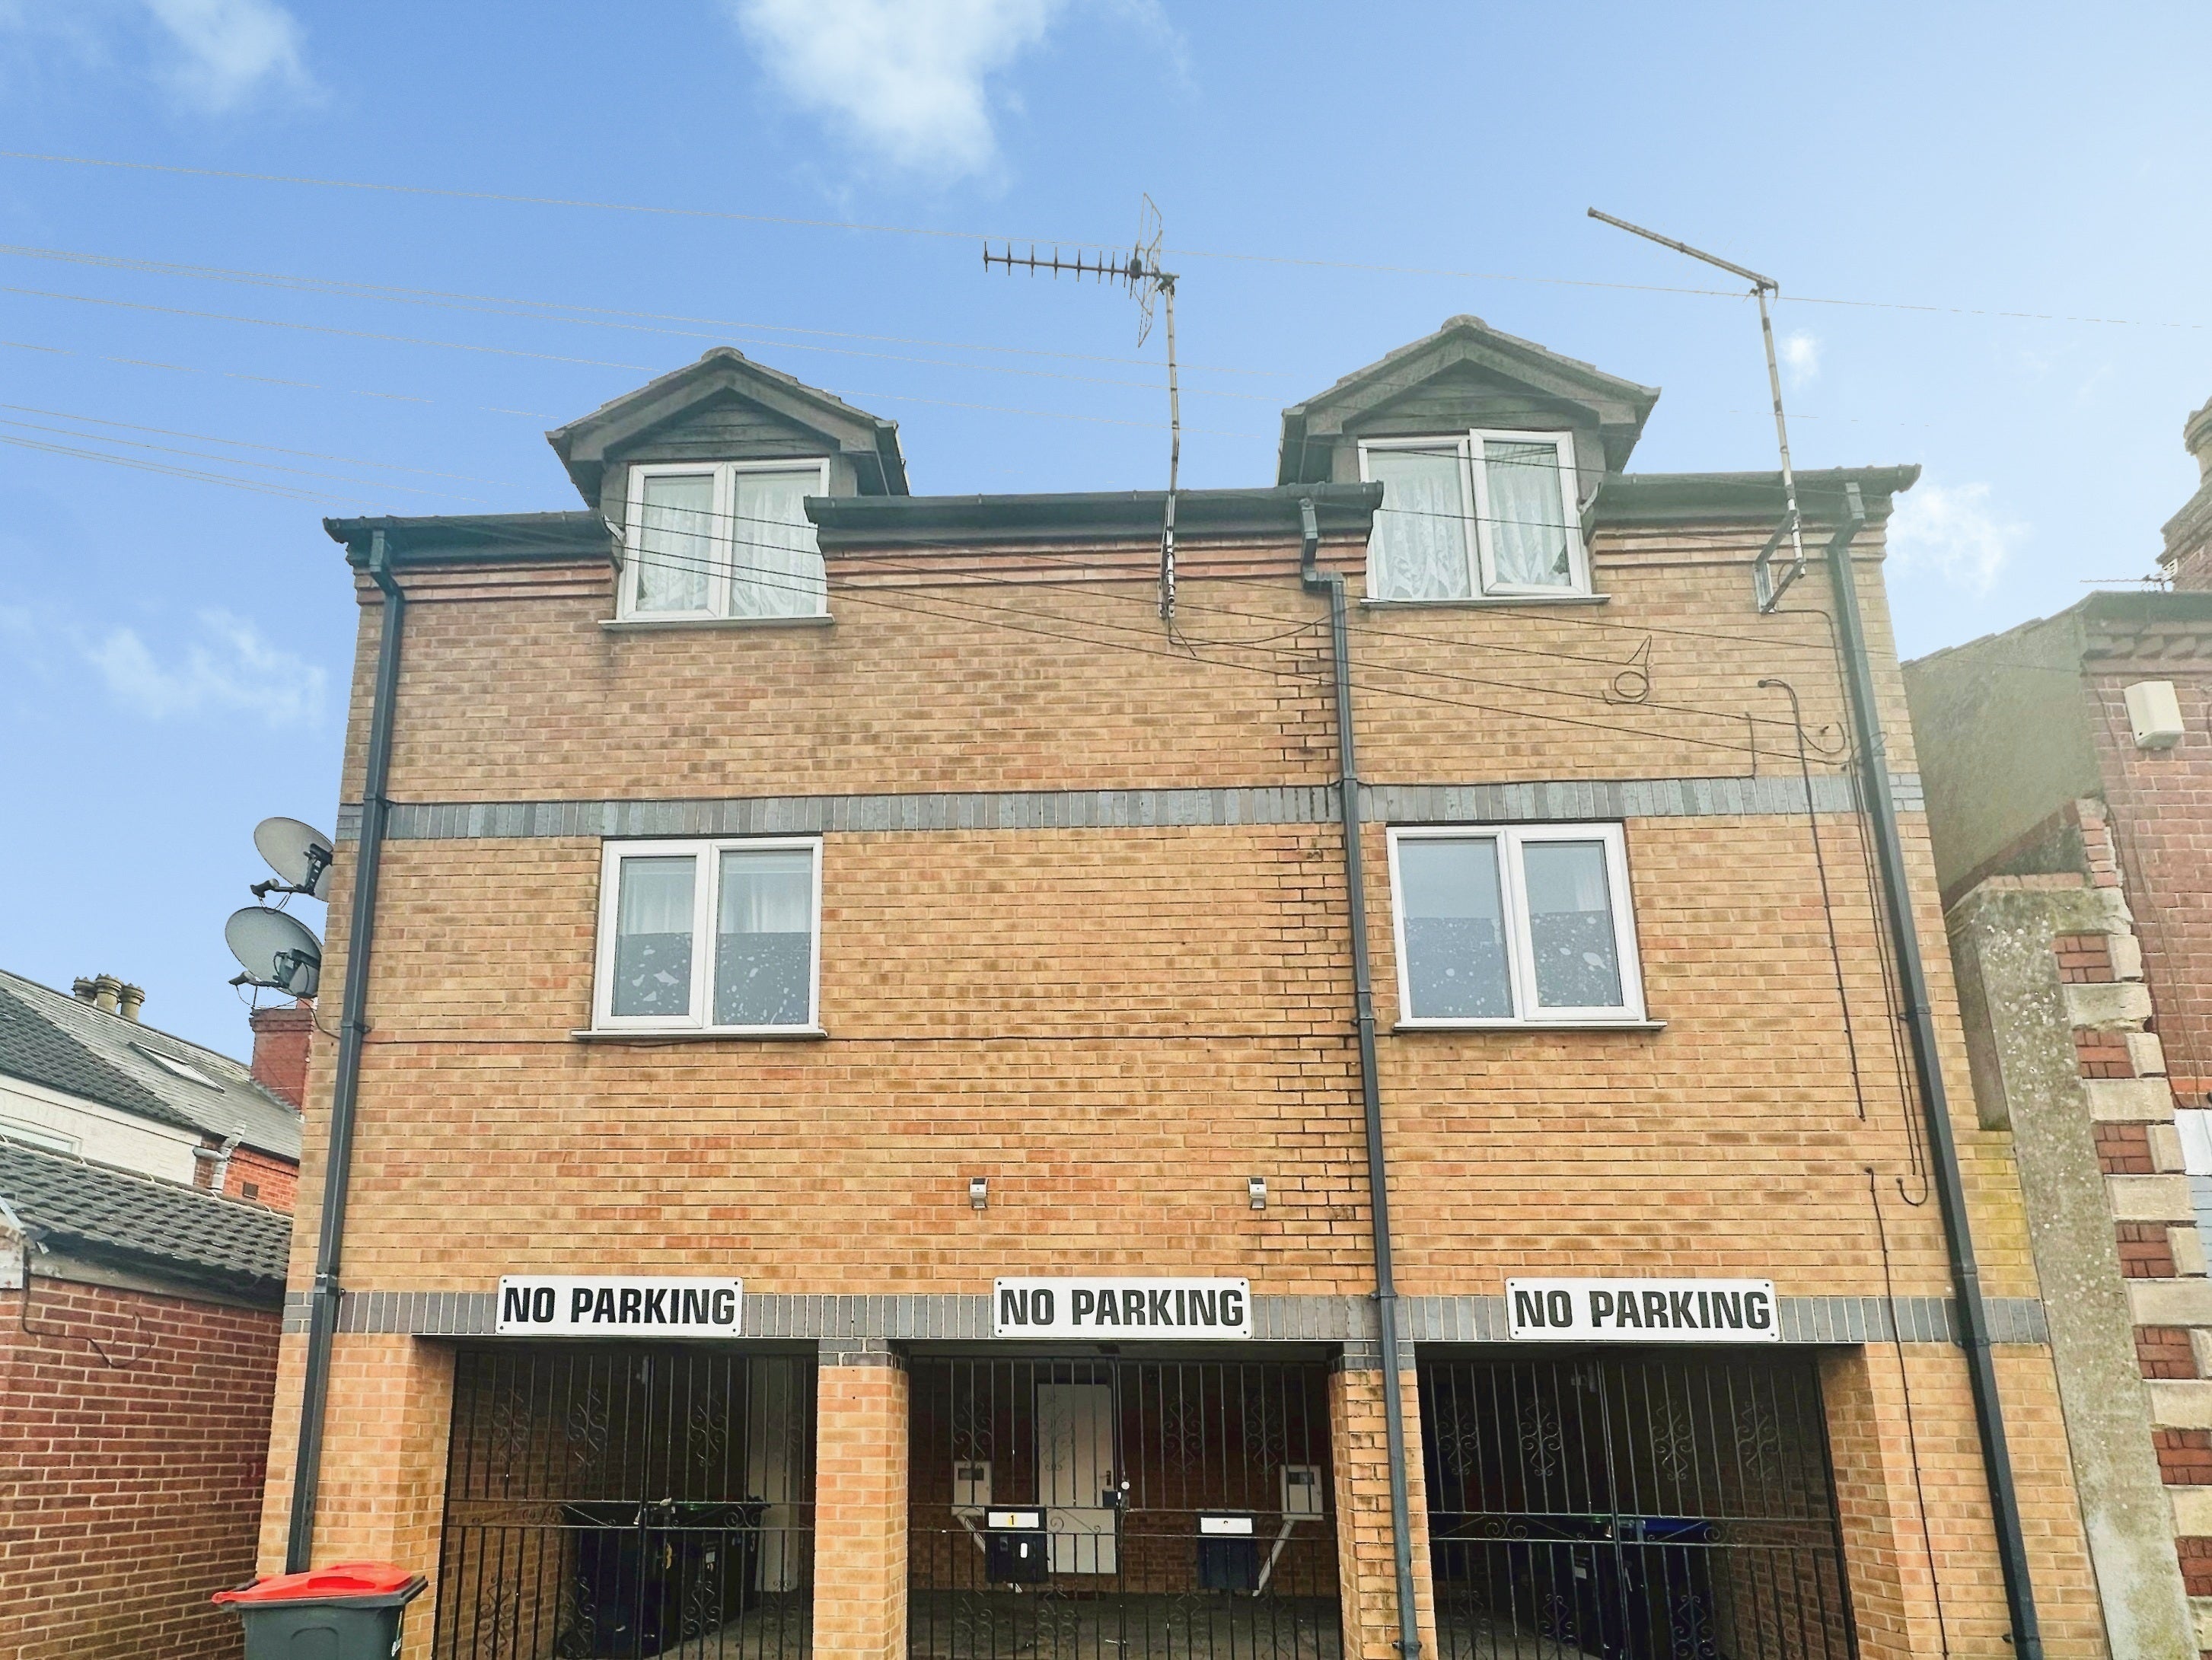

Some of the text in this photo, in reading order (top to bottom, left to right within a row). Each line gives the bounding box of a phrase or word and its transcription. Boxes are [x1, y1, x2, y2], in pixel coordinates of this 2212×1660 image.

[502, 1287, 735, 1325] NO PARKING
[1000, 1289, 1243, 1327] NO PARKING
[1514, 1290, 1771, 1330] NO PARKING
[1010, 1515, 1015, 1525] 1
